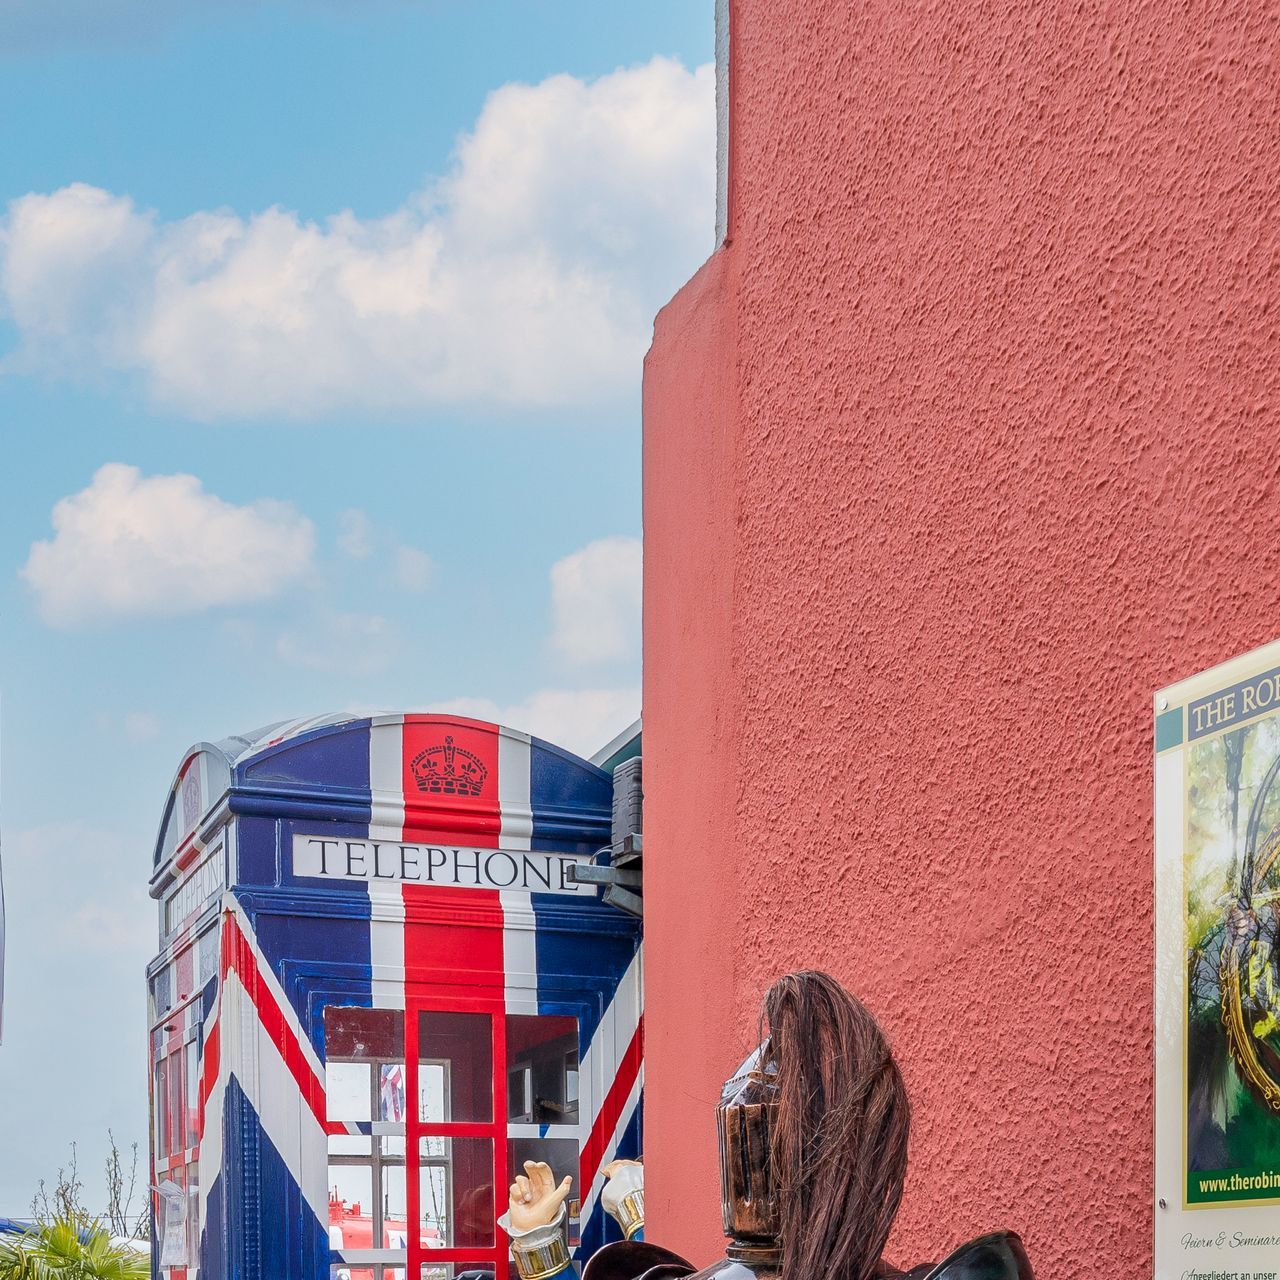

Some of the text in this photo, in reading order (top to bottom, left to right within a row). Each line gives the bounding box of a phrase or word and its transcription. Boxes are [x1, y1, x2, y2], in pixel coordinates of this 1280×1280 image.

[1192, 692, 1237, 733] THE
[308, 839, 580, 891] TELEPHONE
[1181, 1232, 1214, 1250] Feiern
[1215, 1231, 1227, 1247] &
[1240, 1272, 1250, 1280] an
[1252, 1272, 1277, 1280] unser
